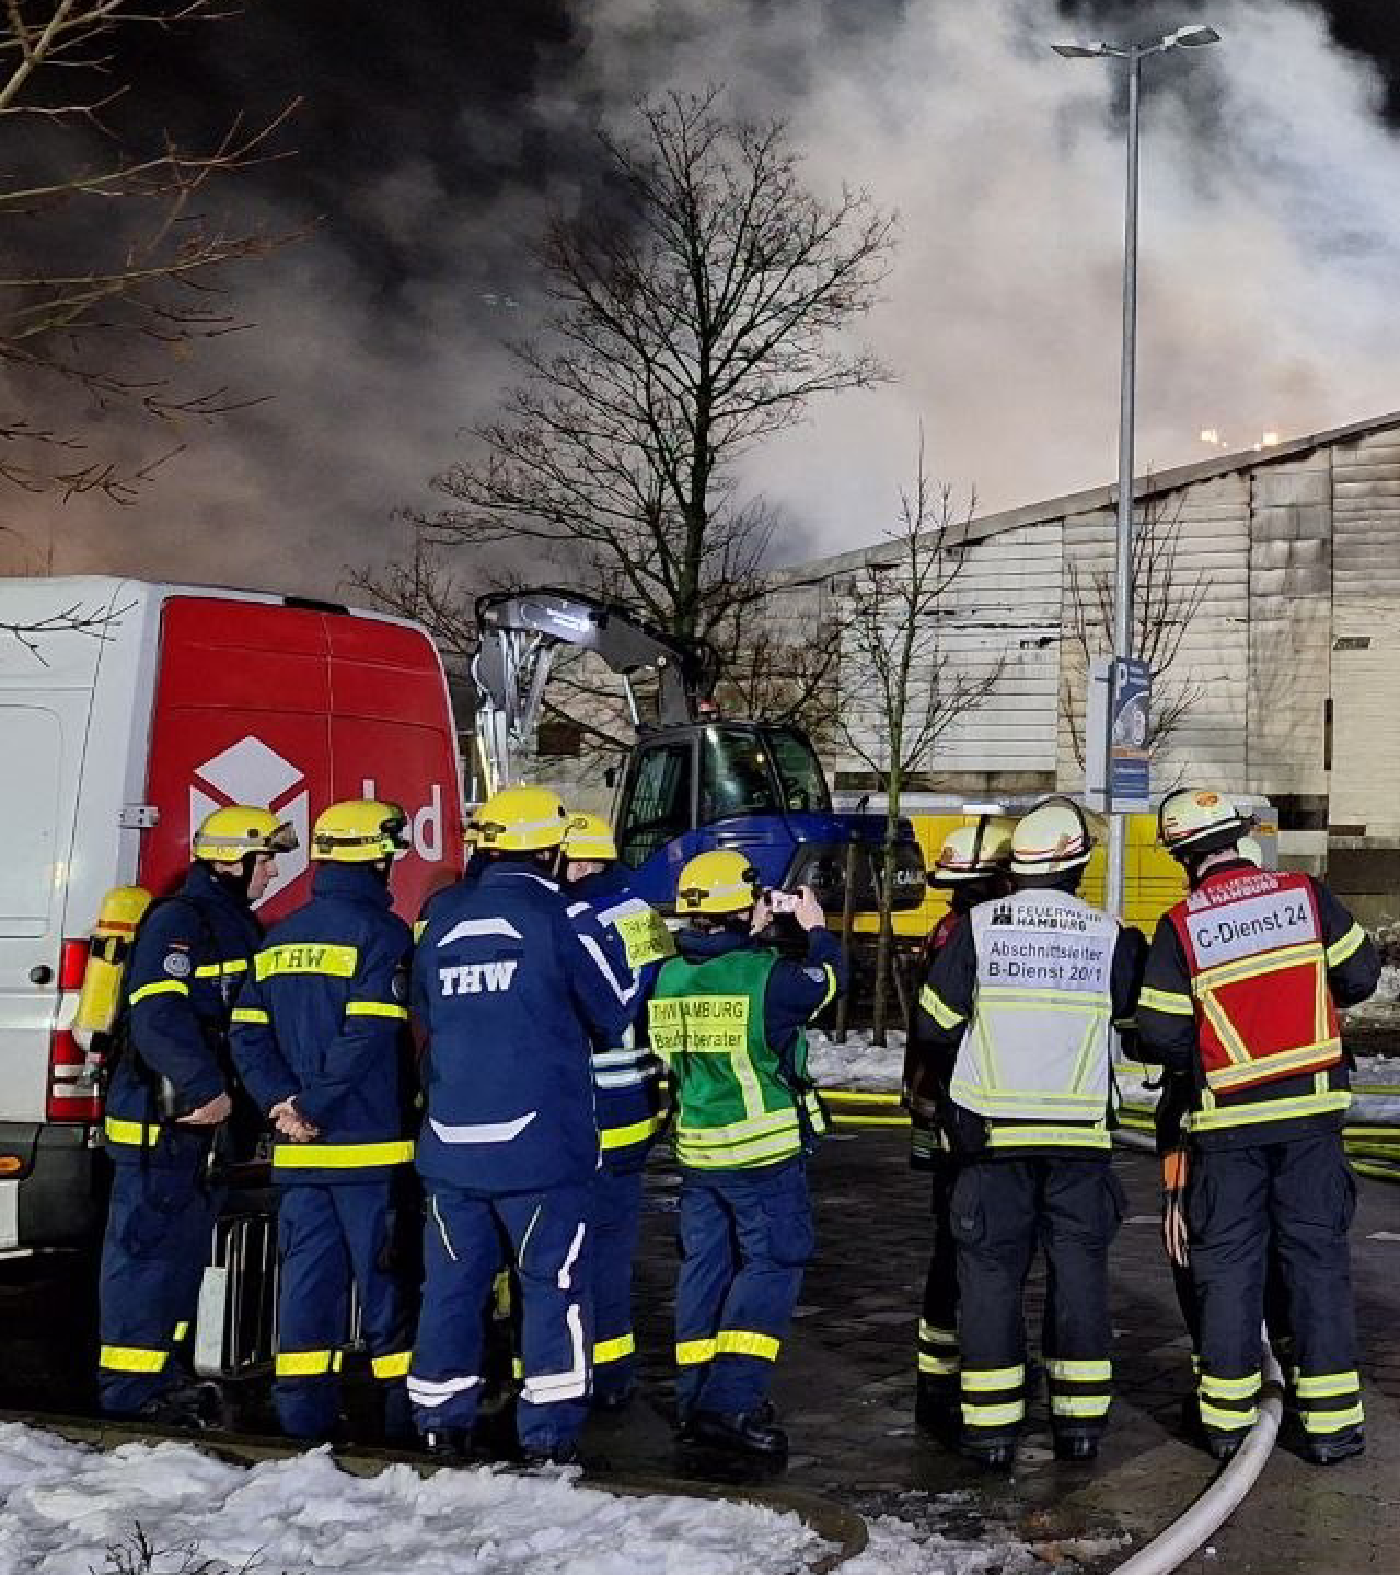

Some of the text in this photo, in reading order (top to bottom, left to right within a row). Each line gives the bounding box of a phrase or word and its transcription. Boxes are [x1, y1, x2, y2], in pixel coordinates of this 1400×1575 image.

[1017, 916, 1087, 932] HAMBURG
[1196, 902, 1308, 948] C-Dienst 24
[273, 949, 327, 969] THW
[990, 940, 1104, 961] Abschnittsleiter
[439, 960, 518, 996] THW
[989, 961, 1065, 979] B-Dienst
